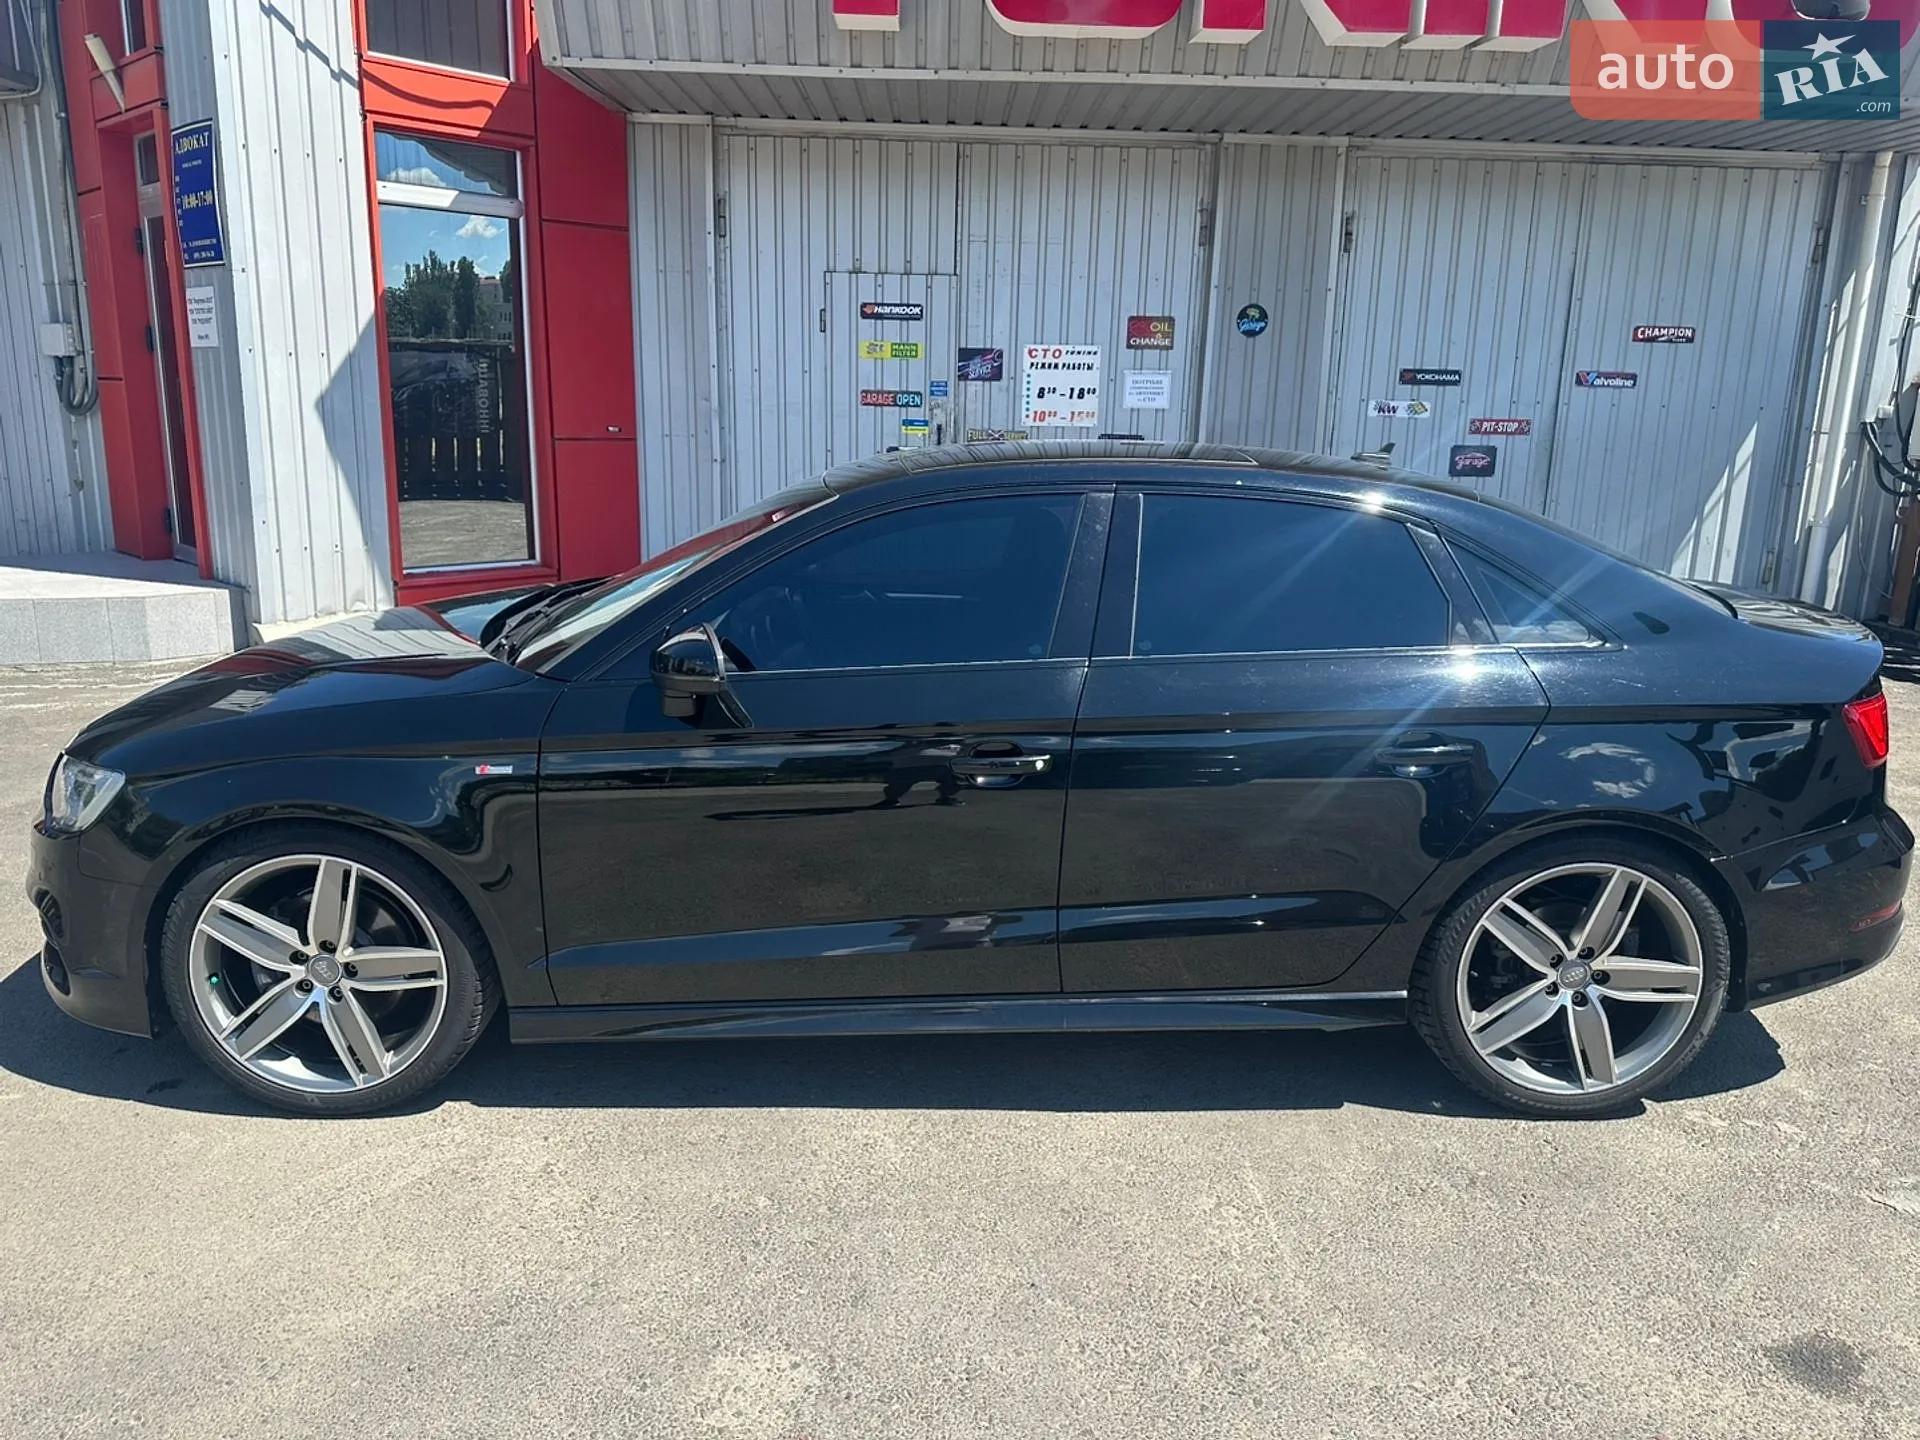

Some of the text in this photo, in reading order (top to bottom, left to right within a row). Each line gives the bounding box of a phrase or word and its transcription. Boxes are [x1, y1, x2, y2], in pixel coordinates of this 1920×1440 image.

[1150, 321, 1172, 332] OIL
[1637, 327, 1692, 339] CHAMPION
[1130, 337, 1172, 346] CHANGE
[1028, 347, 1062, 359] СТО
[1029, 361, 1095, 371] РЕЖИМ РАБОТЫ
[1416, 373, 1460, 381] YOKOHAMA
[1579, 370, 1634, 387] Valvoline
[861, 393, 921, 405] GARAGE OPEN
[1481, 421, 1519, 432] PIT-STOP
